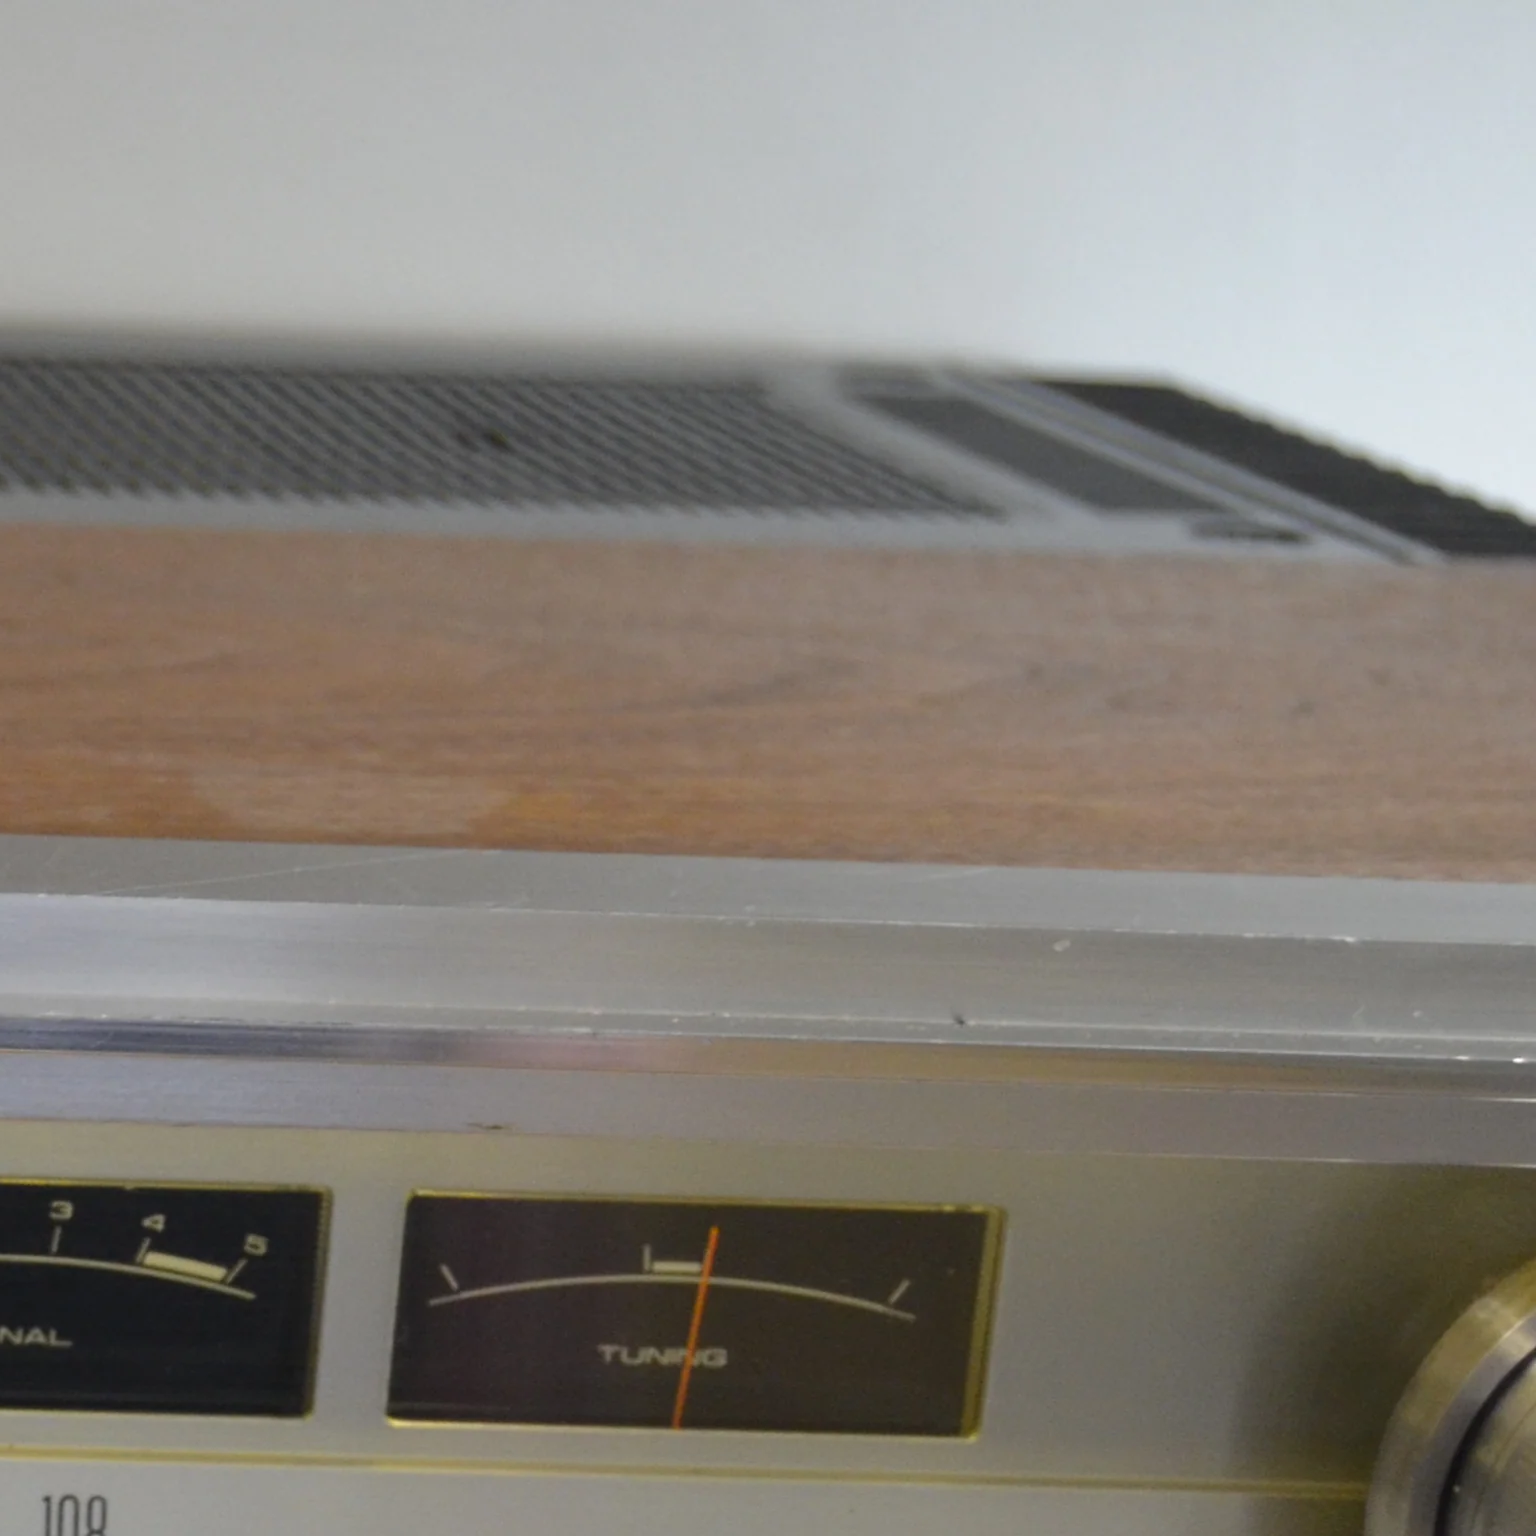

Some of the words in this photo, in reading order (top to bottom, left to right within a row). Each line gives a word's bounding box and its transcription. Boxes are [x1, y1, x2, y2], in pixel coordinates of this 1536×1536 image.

[49, 1202, 74, 1220] 3
[142, 1213, 166, 1233] 4
[244, 1234, 268, 1256] 5
[597, 1344, 728, 1369] TUNING
